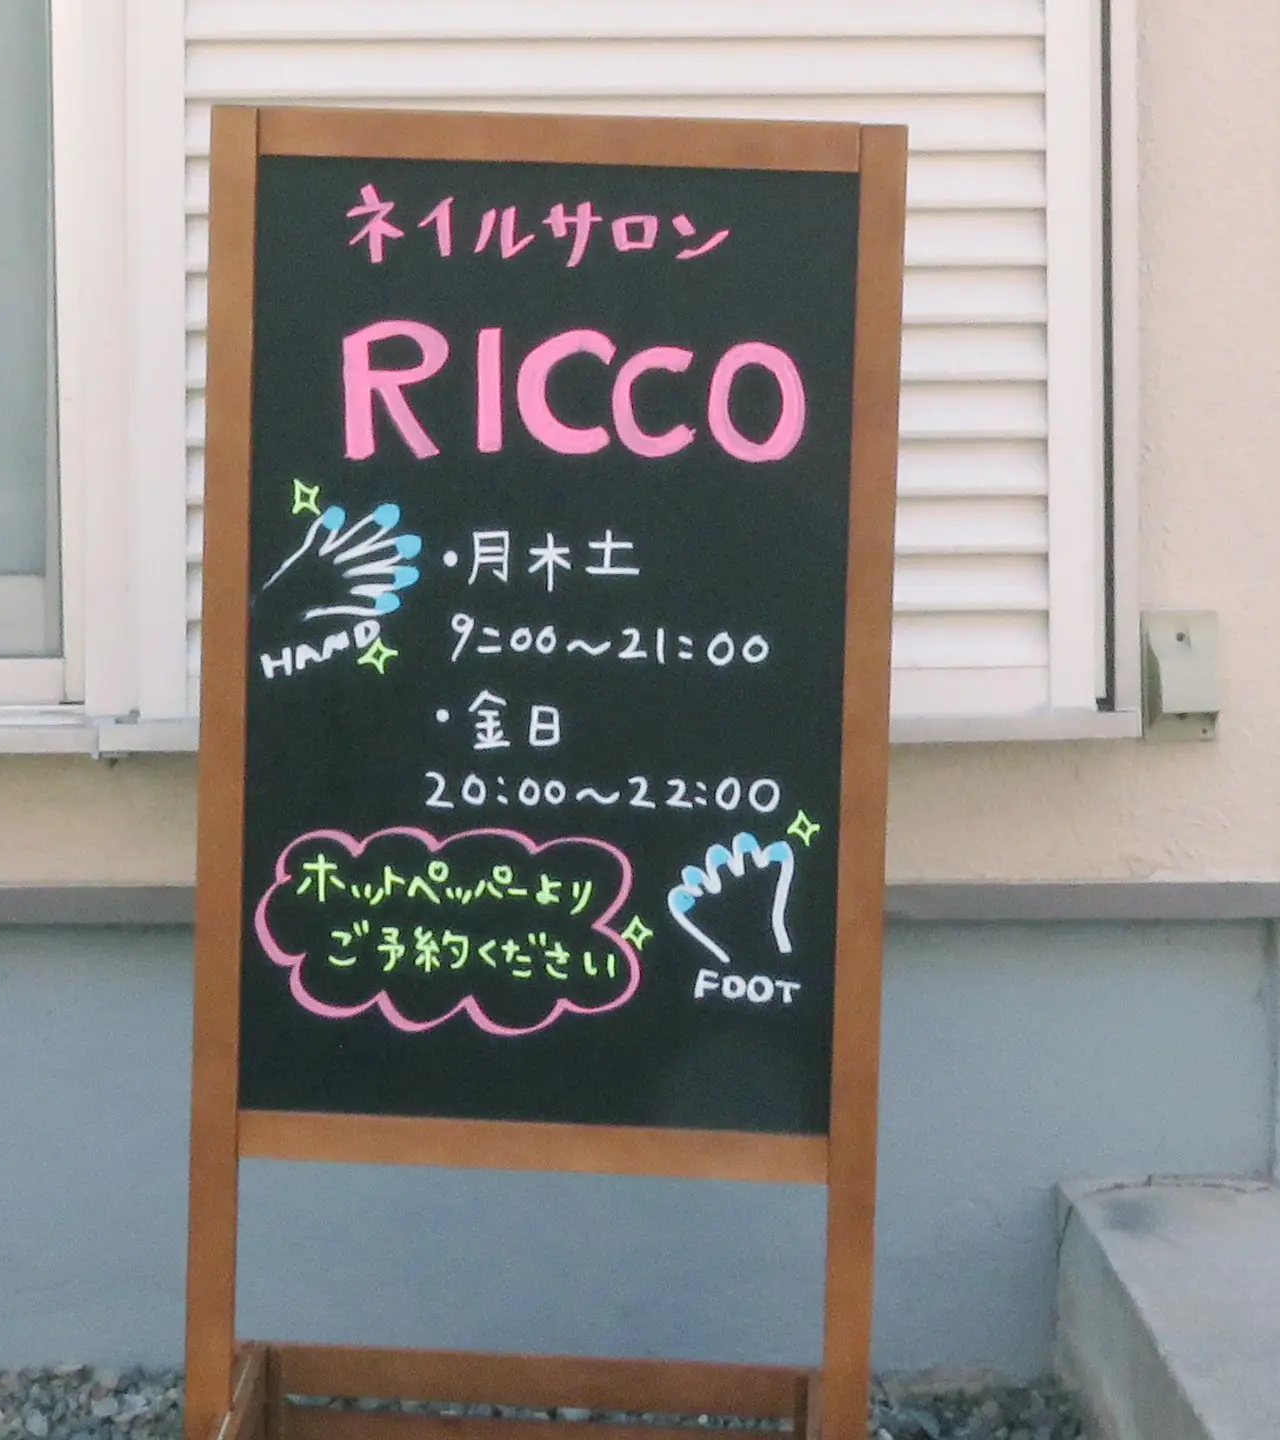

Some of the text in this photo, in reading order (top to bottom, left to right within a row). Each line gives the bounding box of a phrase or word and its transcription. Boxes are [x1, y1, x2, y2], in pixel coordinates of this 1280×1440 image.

[346, 184, 730, 267] ネイルサロン
[342, 319, 806, 463] RICCO
[260, 619, 381, 679] HAND
[296, 853, 592, 915] ホットペッパーより
[328, 919, 617, 979] ご予約ください
[694, 969, 801, 1003] FOOT
